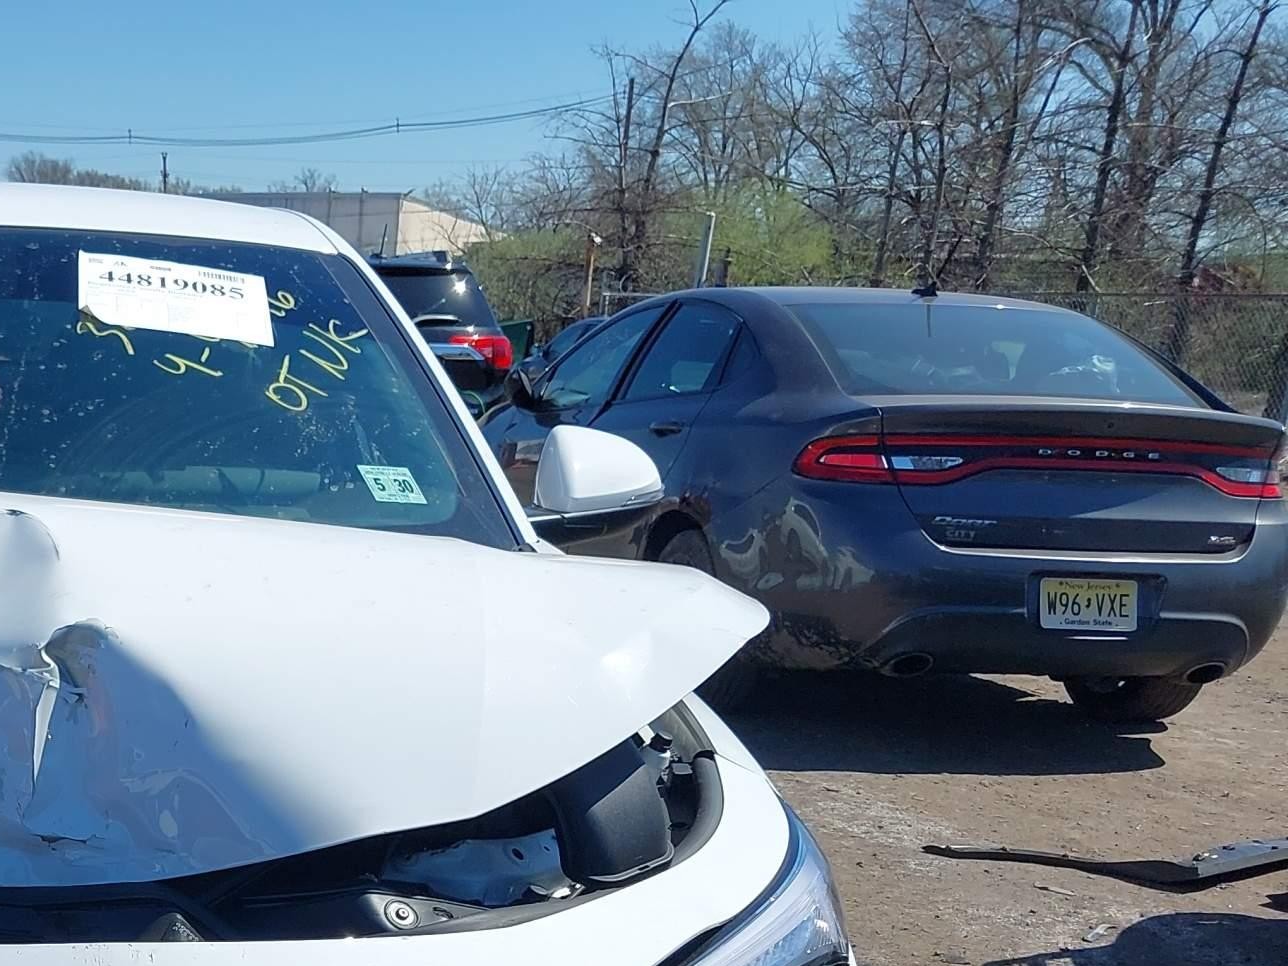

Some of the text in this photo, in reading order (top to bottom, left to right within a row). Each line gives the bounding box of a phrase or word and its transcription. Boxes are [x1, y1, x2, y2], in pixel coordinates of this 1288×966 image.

[99, 270, 245, 300] 44819085
[1038, 448, 1160, 460] DODGE
[373, 477, 414, 493] 5 30
[1064, 581, 1112, 592] New Jersey
[1064, 617, 1113, 627] Garden State
